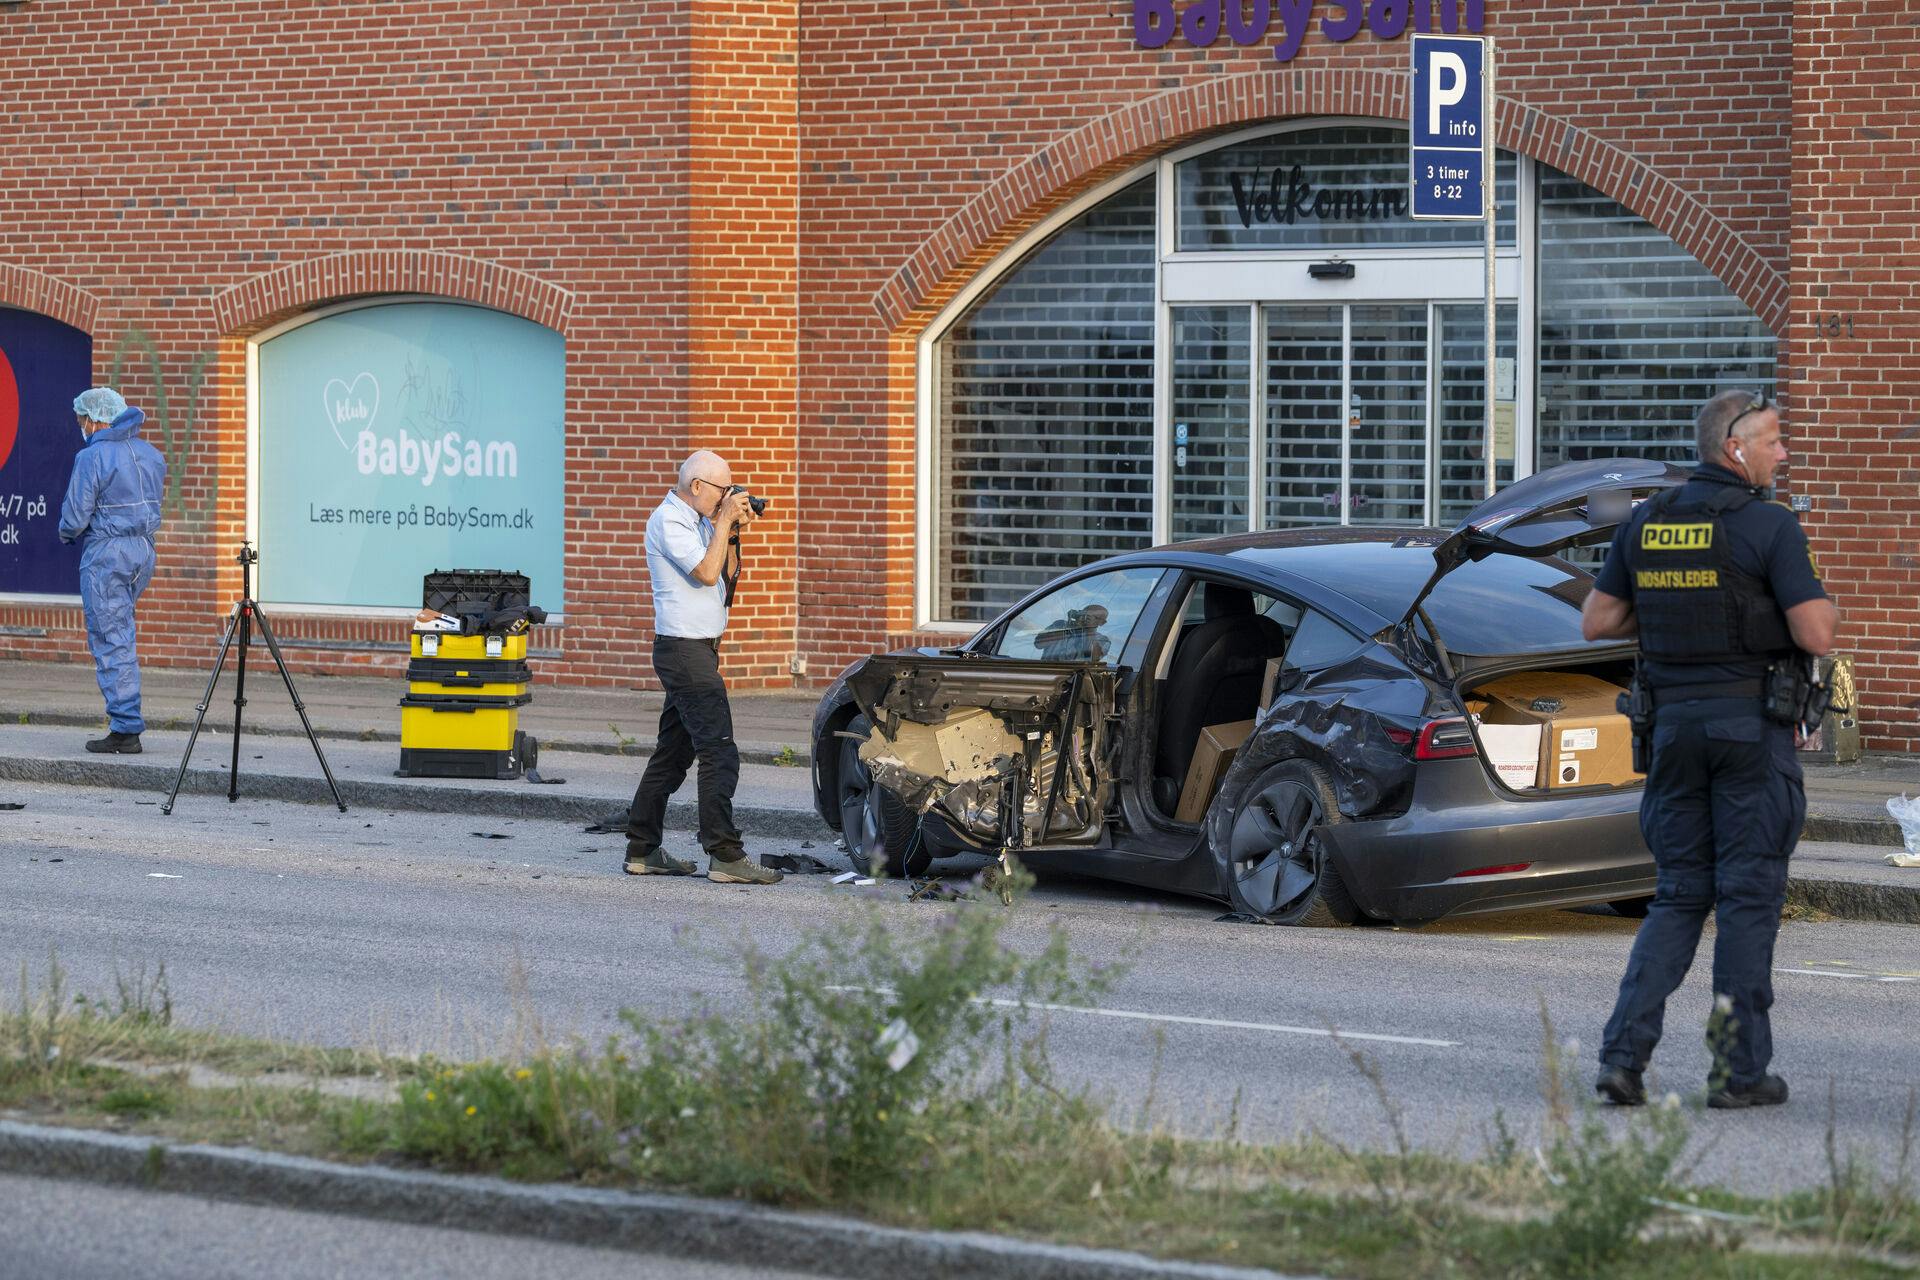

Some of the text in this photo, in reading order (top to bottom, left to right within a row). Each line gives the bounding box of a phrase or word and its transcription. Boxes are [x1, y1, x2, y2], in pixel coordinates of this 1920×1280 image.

[1429, 51, 1467, 135] P
[1450, 120, 1476, 136] info
[1427, 165, 1469, 180] 3 timer
[1230, 164, 1409, 228] Velkomm
[1434, 185, 1462, 199] 8-22
[336, 398, 369, 423] klub
[358, 429, 518, 487] BabySam
[0, 494, 47, 520] 4/7 på
[310, 502, 534, 532] Læs mere på BabySam.dk
[0, 523, 20, 544] dk
[1644, 528, 1711, 545] POLITI
